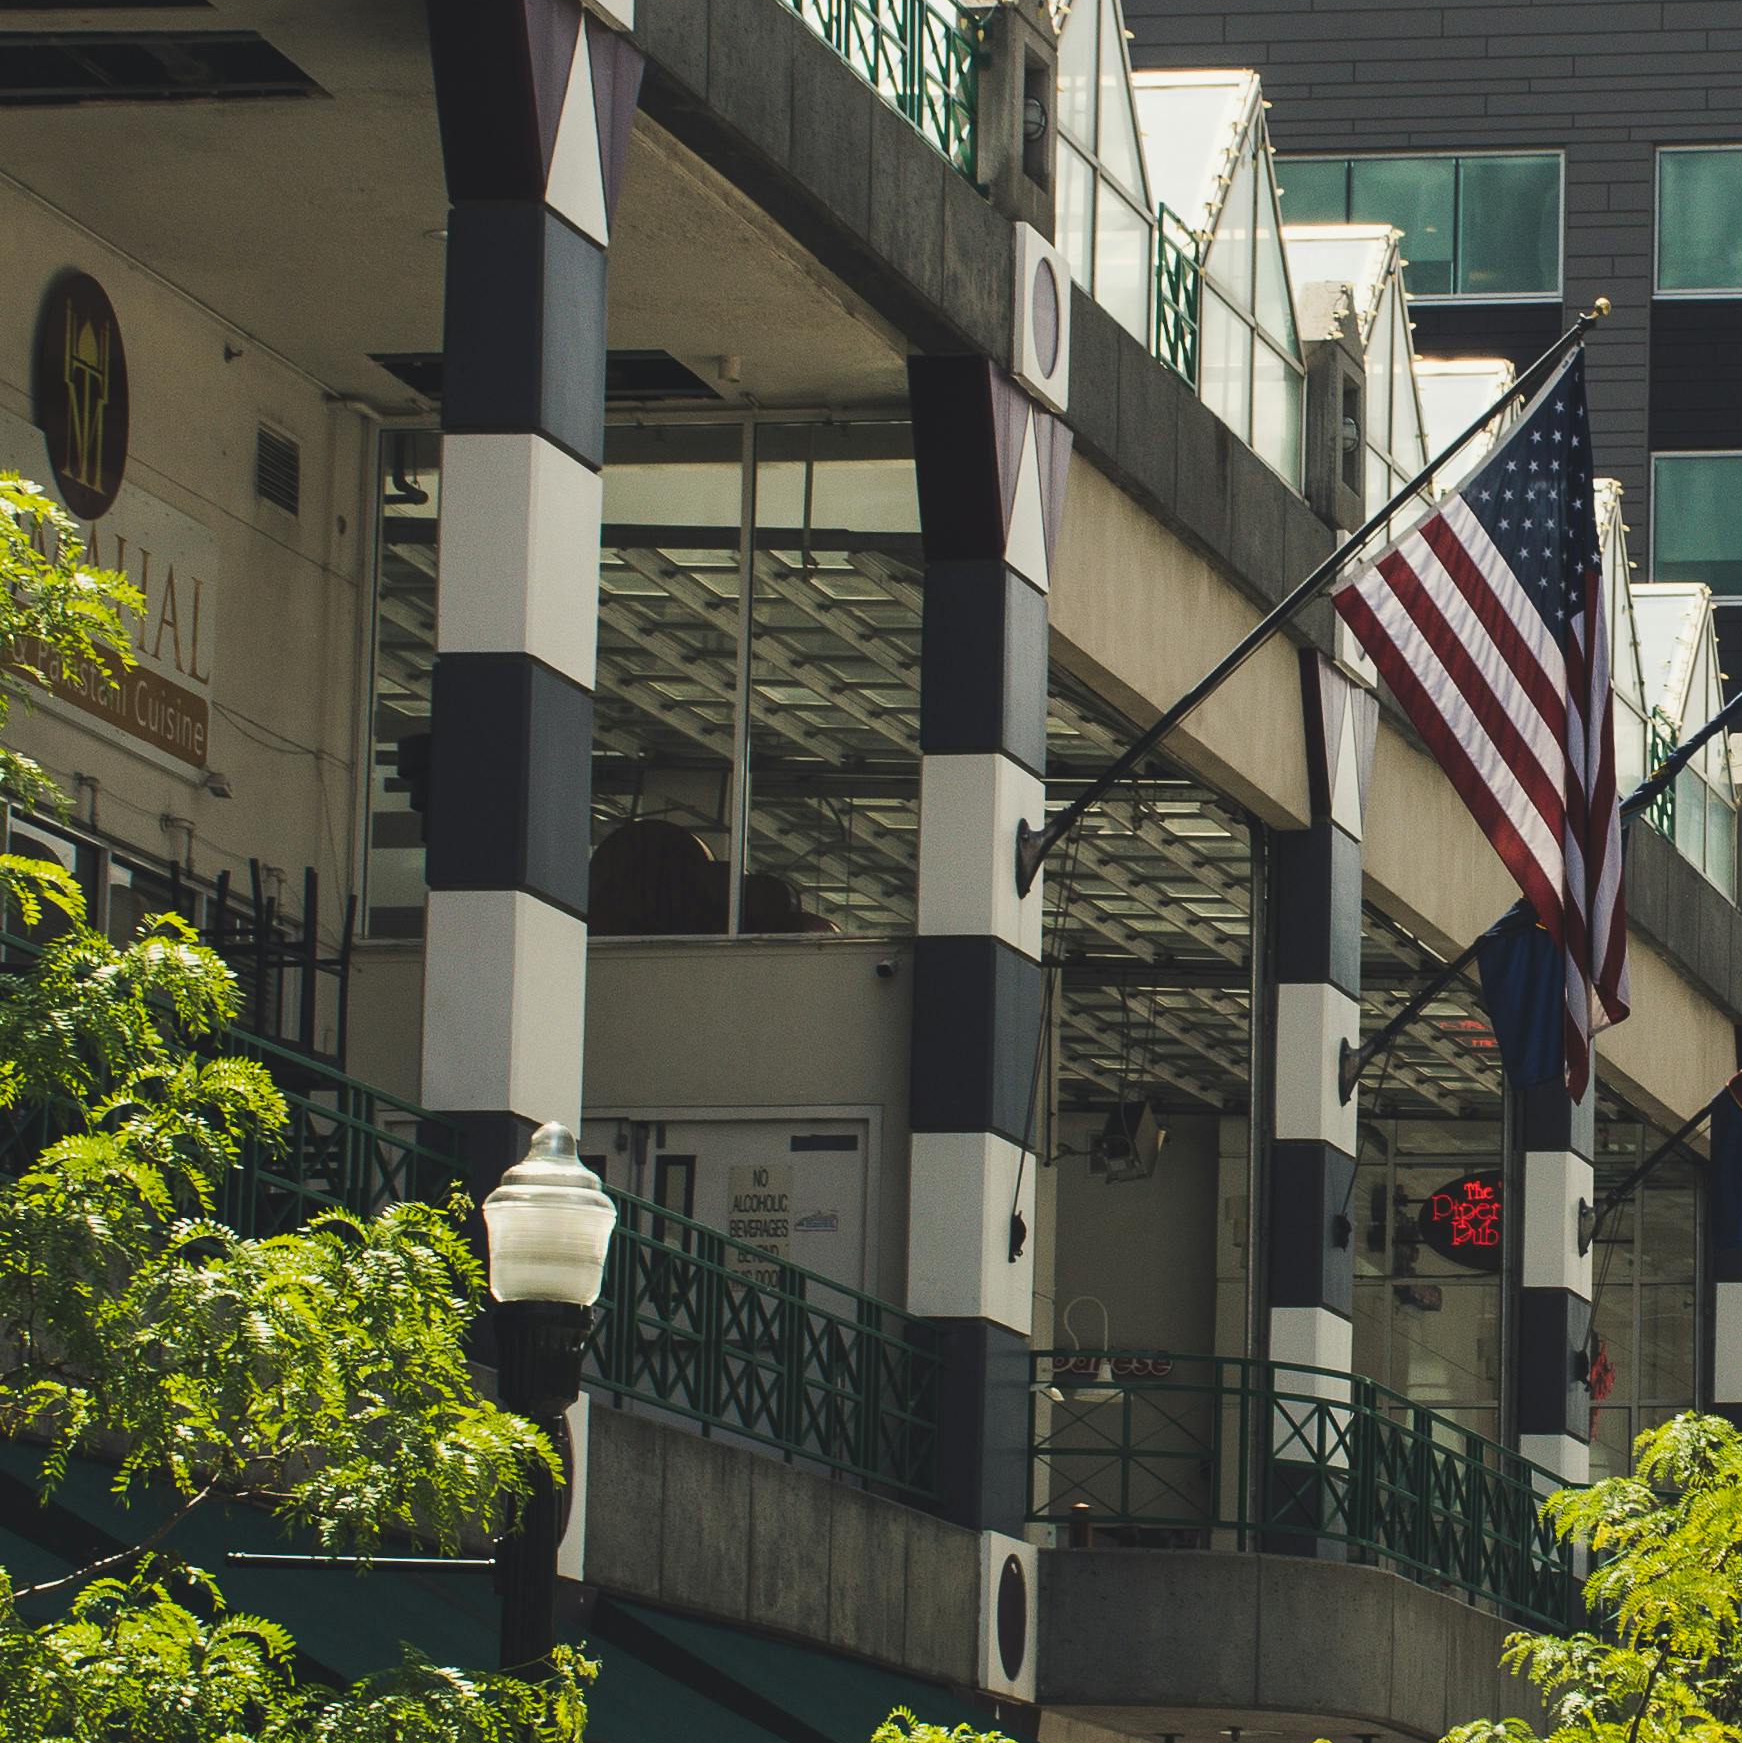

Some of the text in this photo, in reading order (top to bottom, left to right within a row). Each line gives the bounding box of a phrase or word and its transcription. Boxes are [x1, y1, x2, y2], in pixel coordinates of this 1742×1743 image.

[135, 681, 204, 755] Cuisine
[753, 1169, 769, 1187] NO
[1463, 1180, 1495, 1200] The
[732, 1194, 788, 1212] ALCOHOLIC
[1431, 1194, 1500, 1228] Piper
[729, 1219, 789, 1238] BEVERAGES
[1450, 1219, 1500, 1247] Pub
